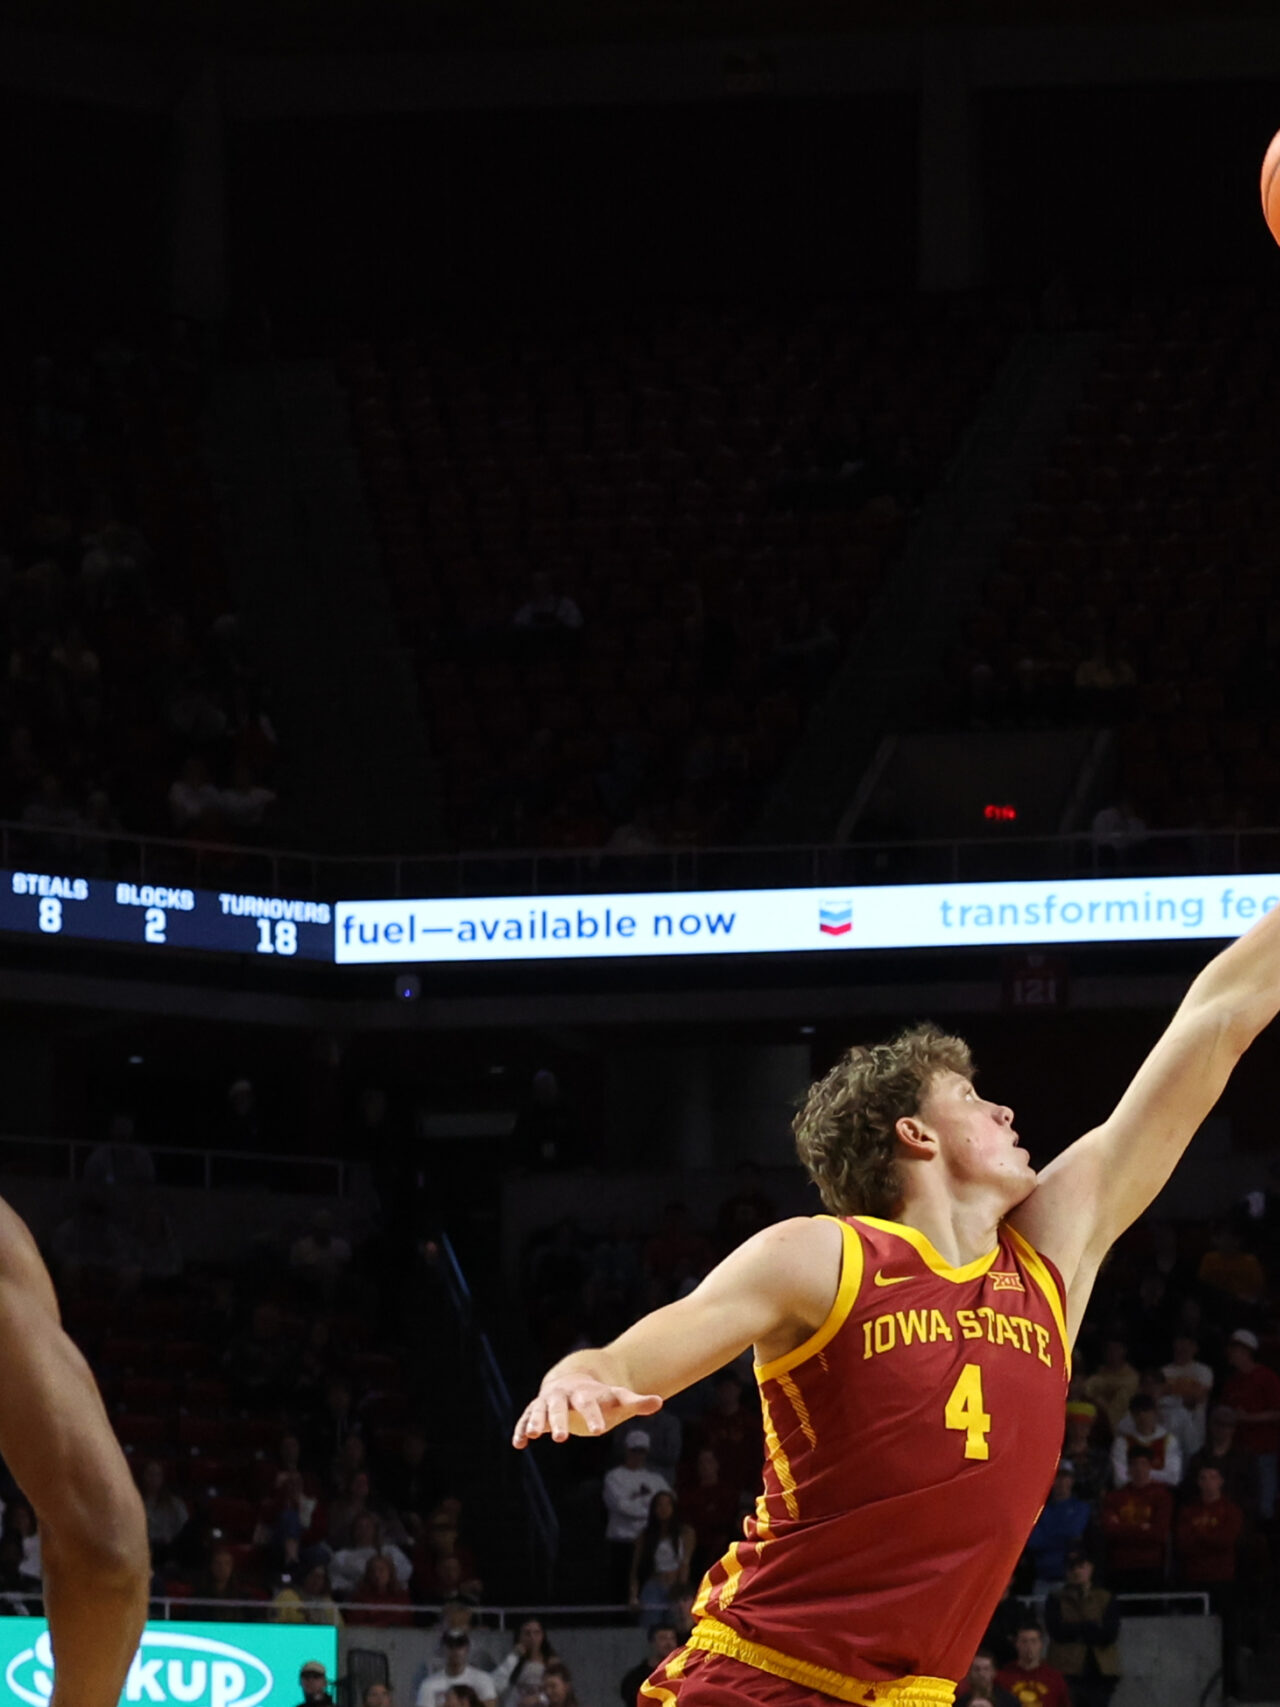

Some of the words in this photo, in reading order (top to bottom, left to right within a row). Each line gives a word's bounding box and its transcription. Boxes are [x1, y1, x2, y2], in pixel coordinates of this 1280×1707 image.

[13, 872, 88, 900] STEALS
[117, 883, 194, 911] BLOCKS
[219, 893, 330, 924] TURNOVERS
[653, 910, 737, 938] now
[940, 891, 1204, 928] transforming
[38, 898, 61, 933] 8
[145, 909, 166, 943] 2
[256, 919, 297, 956] 18
[862, 1309, 954, 1360] IOWA
[956, 1306, 1053, 1368] STATE
[945, 1363, 991, 1460] 4
